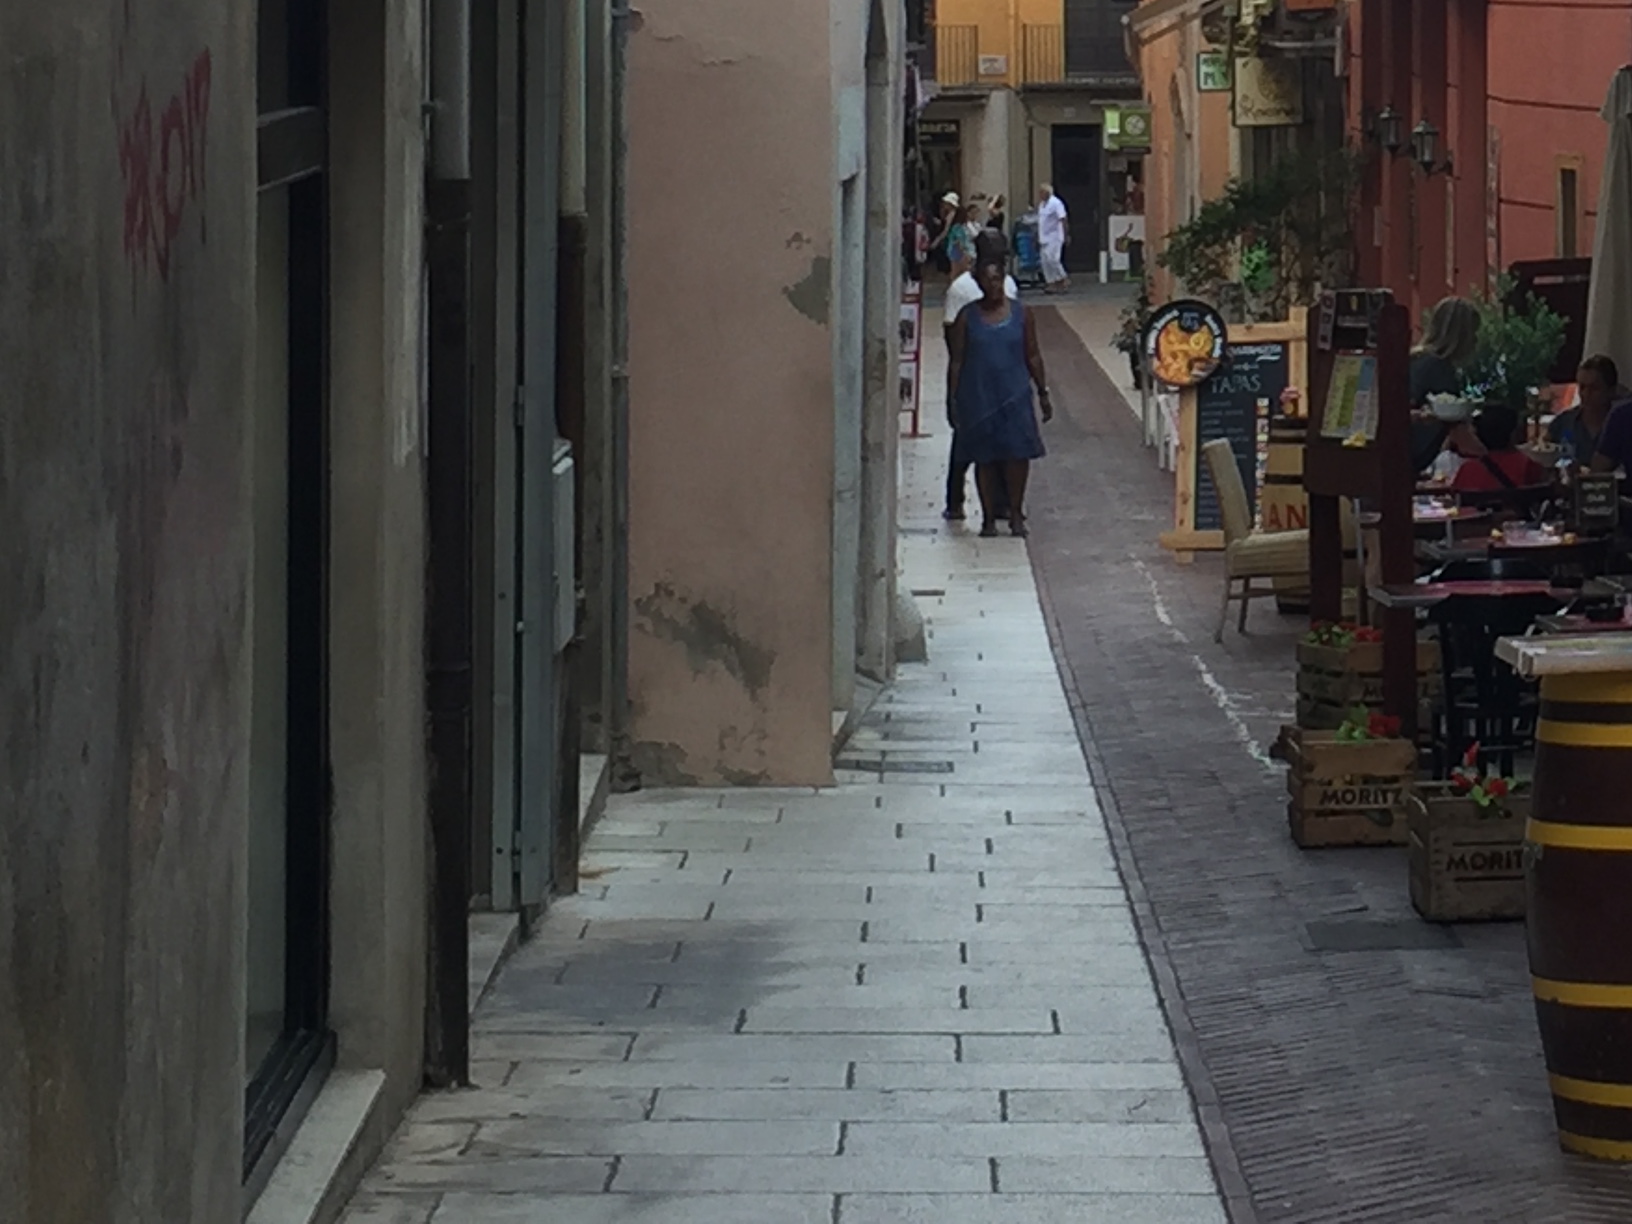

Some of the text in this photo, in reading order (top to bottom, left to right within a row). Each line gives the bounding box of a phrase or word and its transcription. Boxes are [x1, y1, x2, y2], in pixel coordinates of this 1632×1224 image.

[1210, 373, 1262, 394] TAPAS
[1319, 787, 1403, 806] MORITZ
[1446, 848, 1524, 872] MORIT
